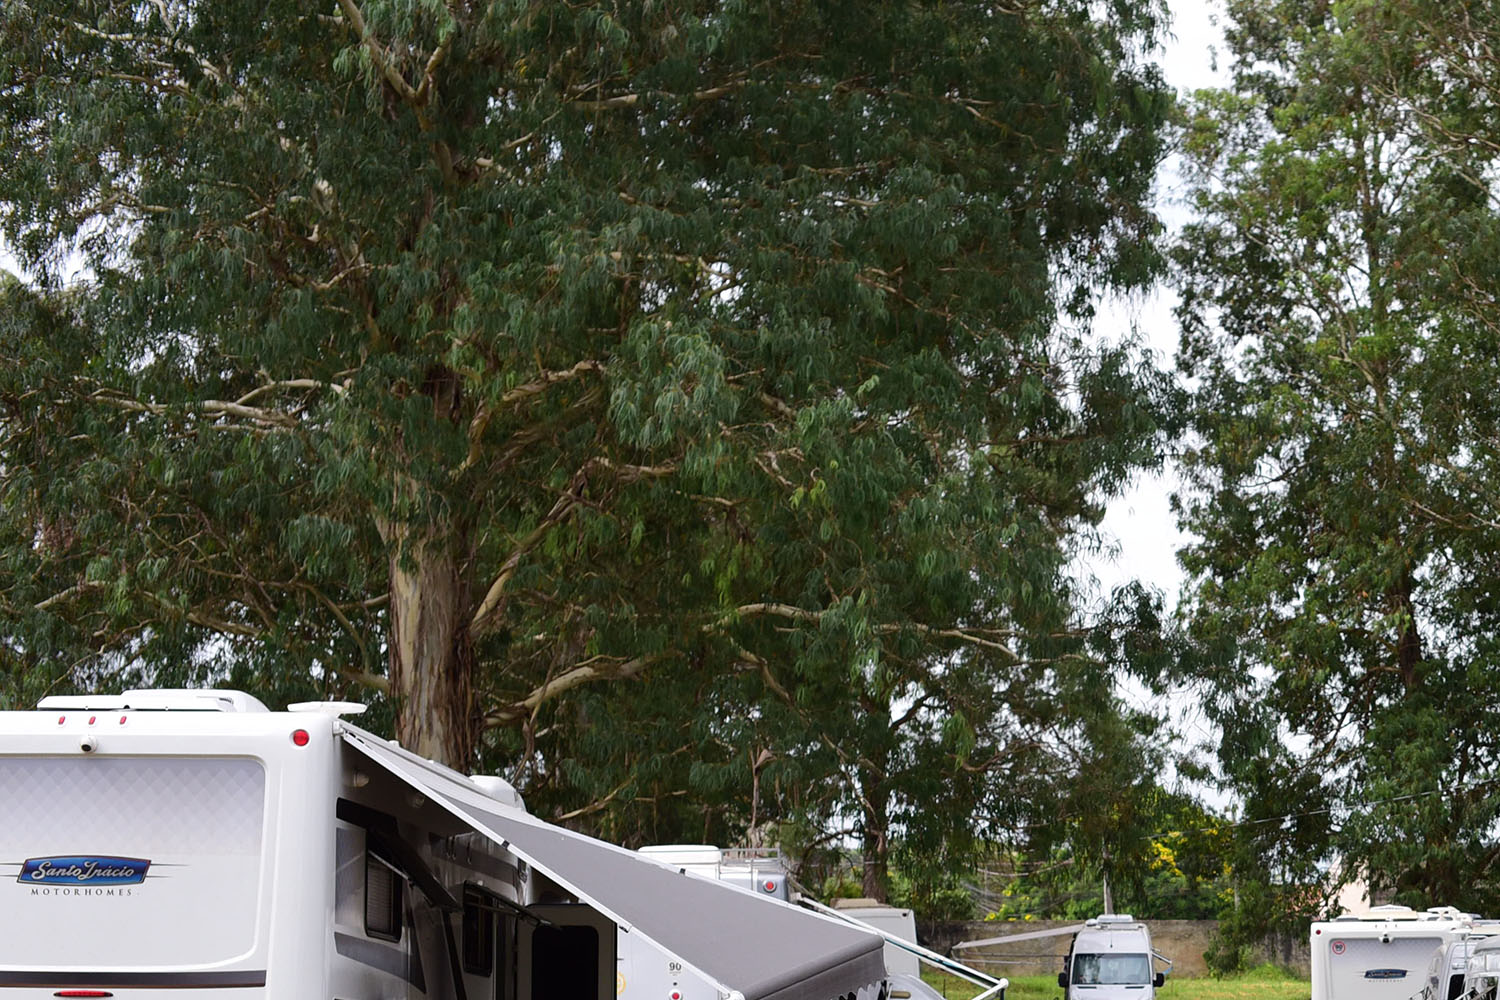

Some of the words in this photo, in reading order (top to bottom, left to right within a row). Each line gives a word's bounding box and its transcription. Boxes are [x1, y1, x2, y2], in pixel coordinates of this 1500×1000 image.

[31, 861, 81, 880] Santo
[77, 861, 135, 880] Inácio
[30, 888, 132, 896] MOTORHOMES
[669, 962, 682, 971] 90
